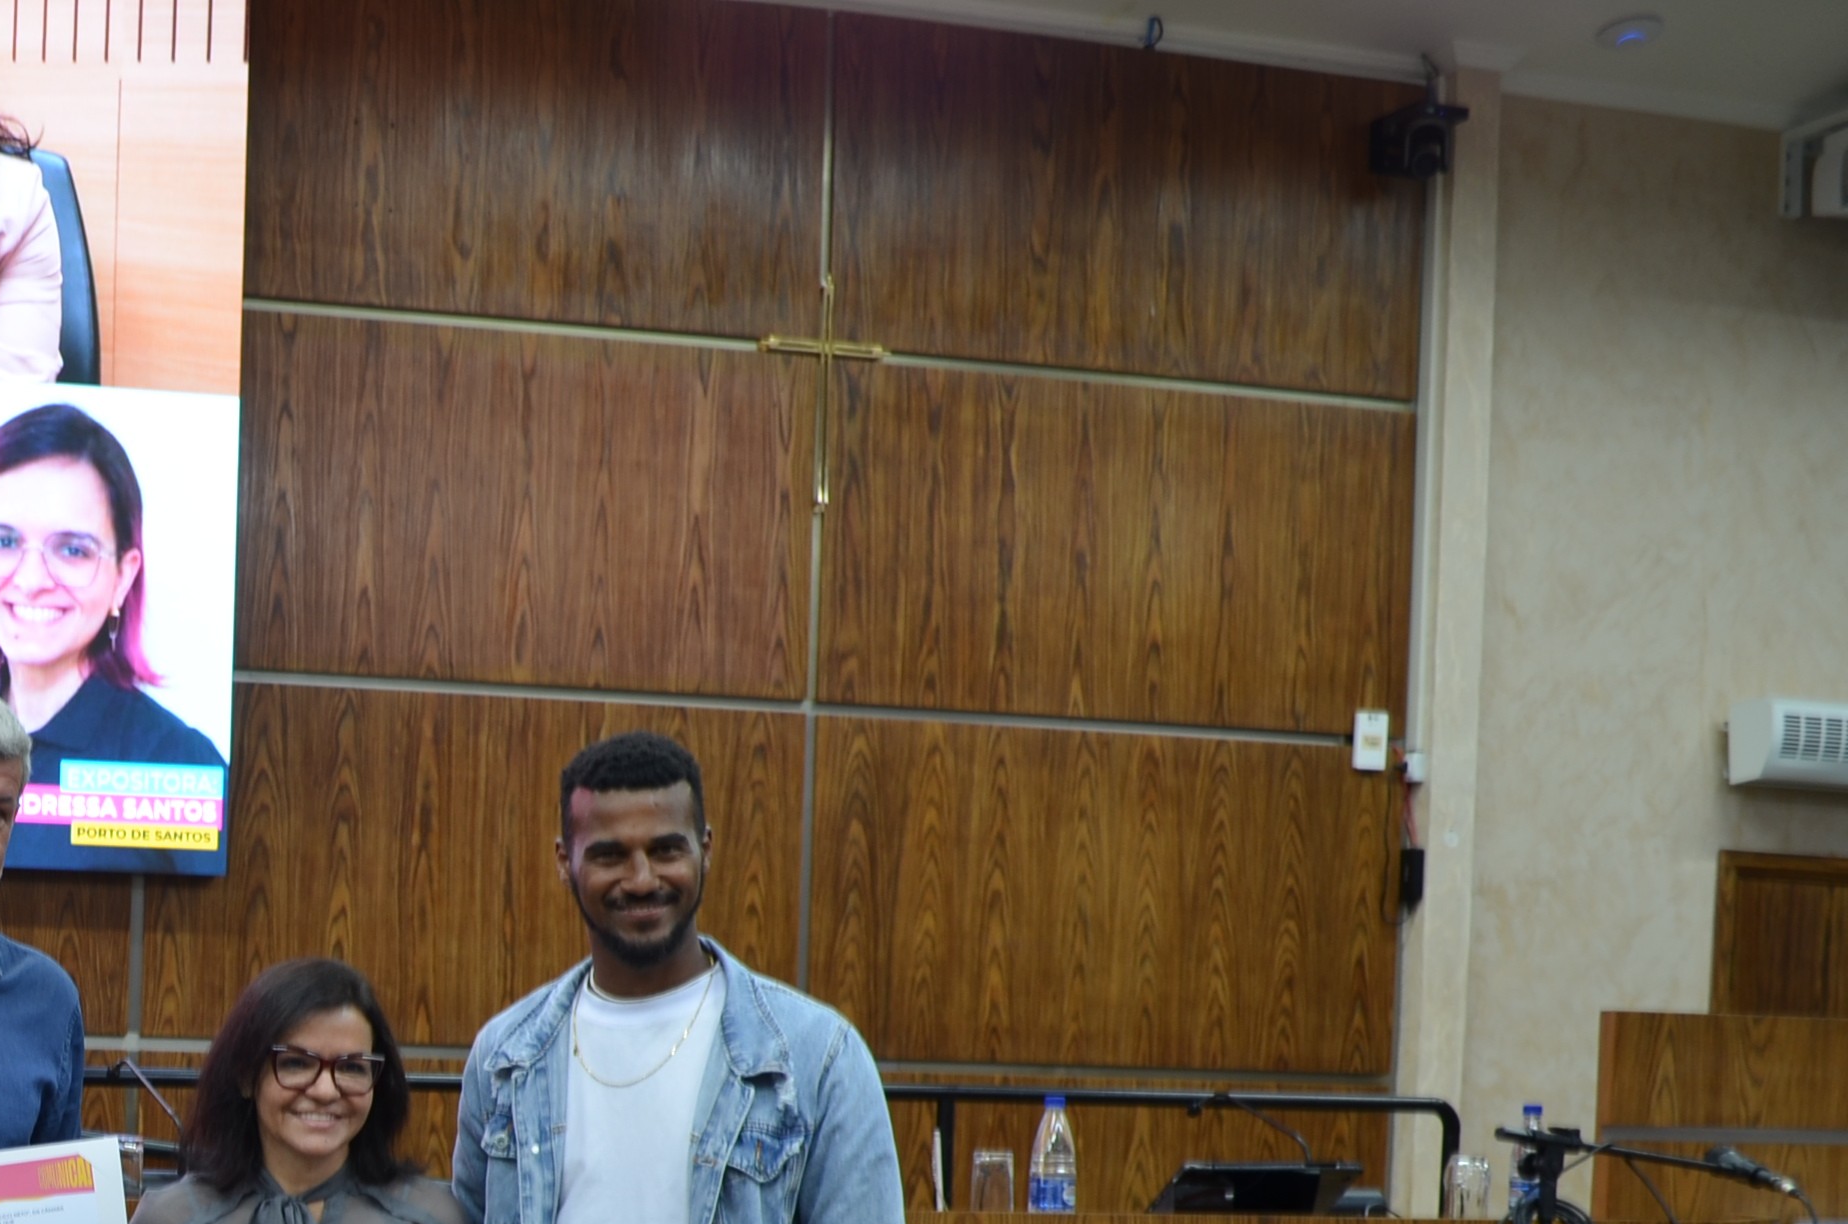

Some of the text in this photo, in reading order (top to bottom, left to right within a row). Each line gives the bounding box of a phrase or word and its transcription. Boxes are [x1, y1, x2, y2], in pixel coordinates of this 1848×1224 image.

[67, 767, 218, 794] EXPOSITORA:
[122, 797, 218, 823] SANTOS
[76, 827, 211, 843] PORTO DE SANTOS
